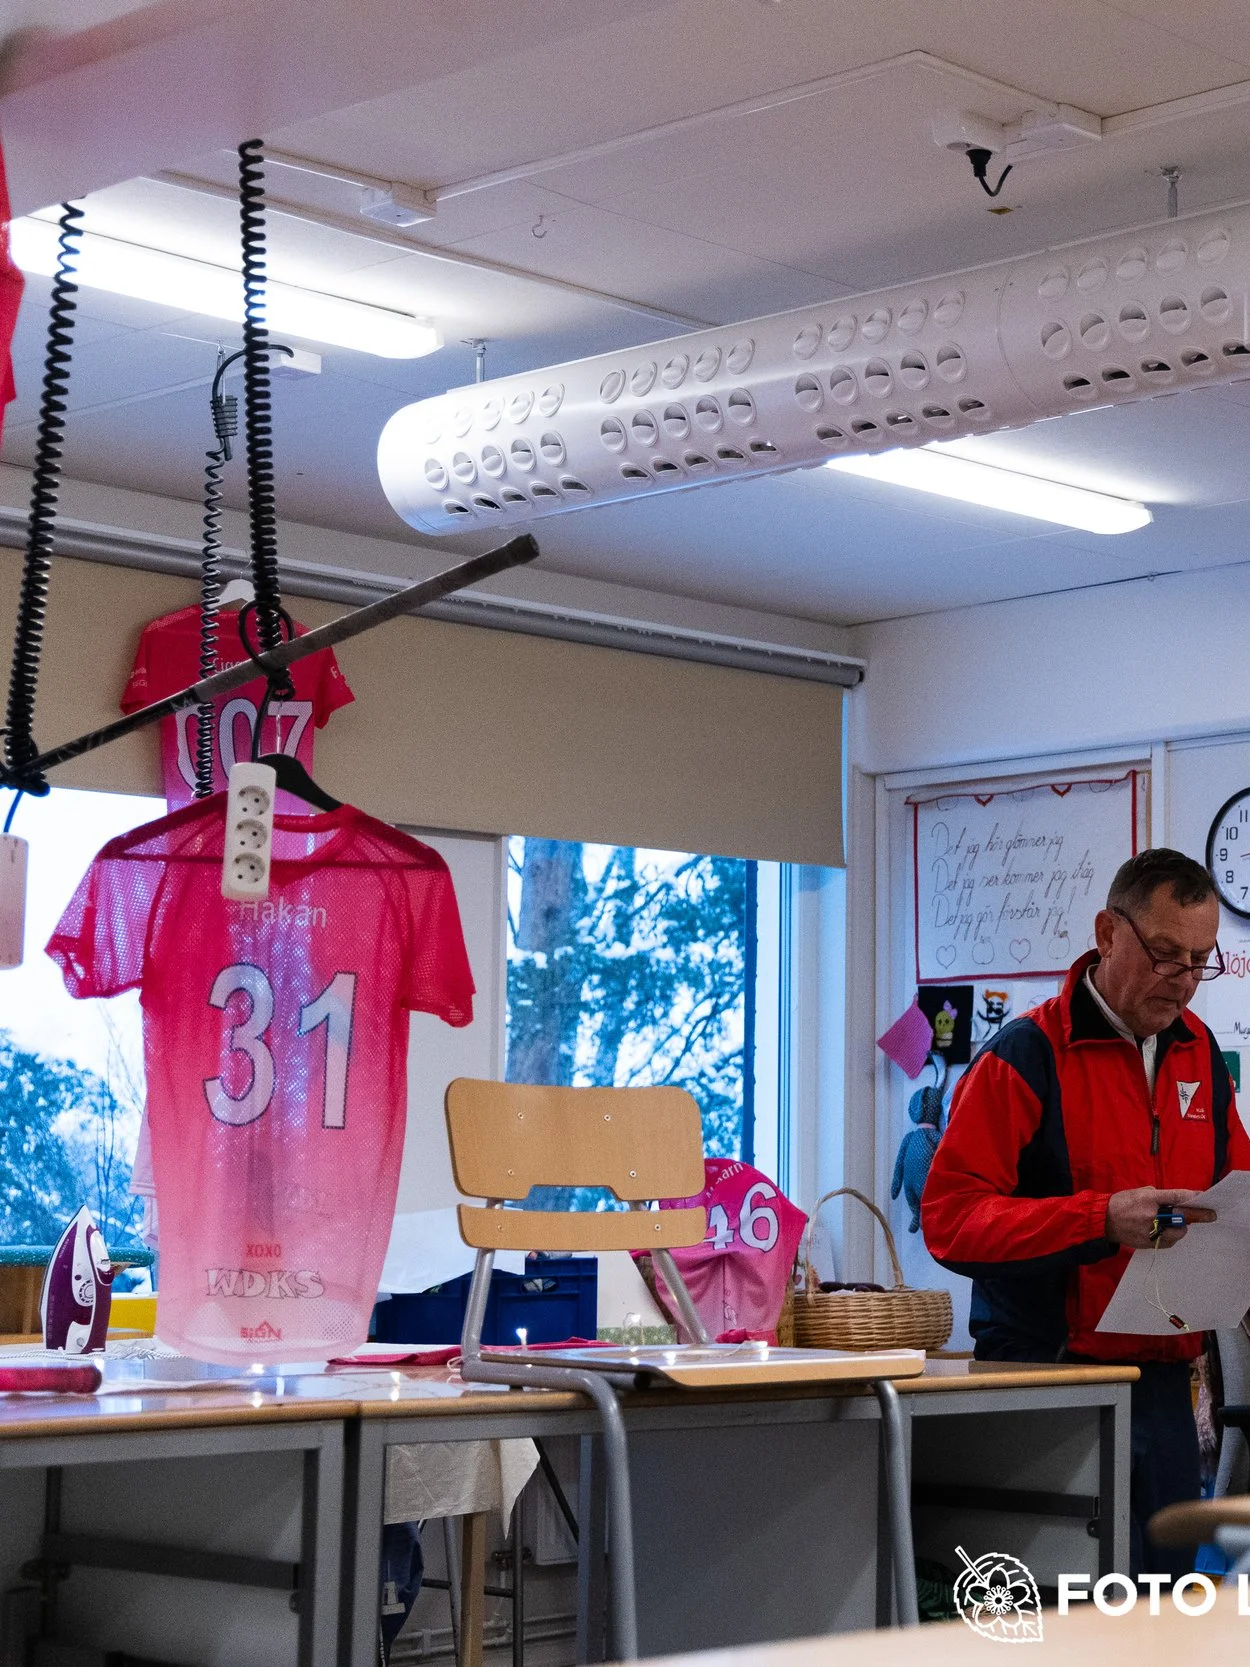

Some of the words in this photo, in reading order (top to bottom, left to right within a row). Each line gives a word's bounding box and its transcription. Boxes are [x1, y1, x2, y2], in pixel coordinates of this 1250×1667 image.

[1239, 809, 1249, 823] 11
[1225, 826, 1239, 840] 10
[1219, 848, 1228, 861] 9
[1225, 870, 1234, 884] 8
[1240, 887, 1249, 900] 7
[203, 961, 358, 1130] 31
[703, 1182, 780, 1253] 46
[245, 1243, 283, 1258] XOXO
[205, 1268, 326, 1299] WDKS
